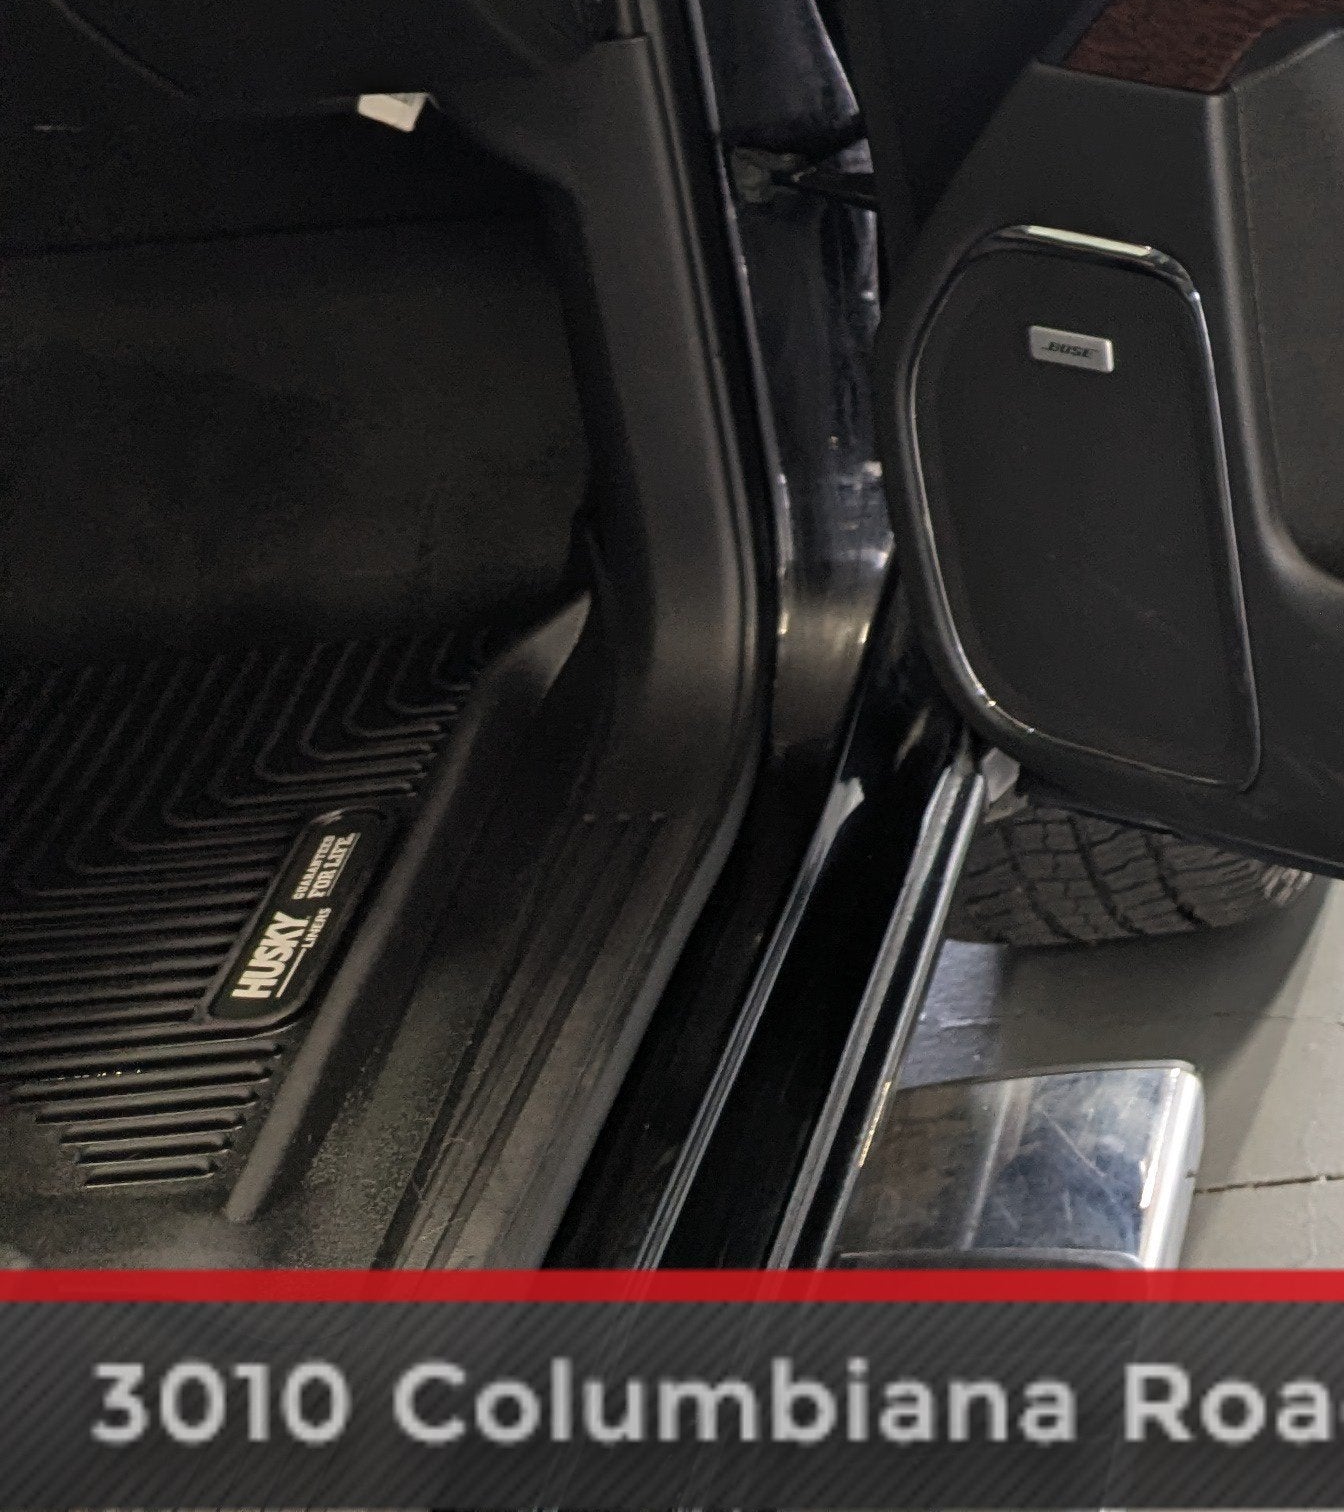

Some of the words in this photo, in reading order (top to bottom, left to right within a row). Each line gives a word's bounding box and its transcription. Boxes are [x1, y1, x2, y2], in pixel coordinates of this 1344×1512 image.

[1046, 341, 1095, 359] BOSE
[307, 869, 336, 899] FOR
[323, 832, 357, 868] LIFE
[231, 911, 309, 999] HUSKY
[302, 908, 332, 949] LINERS
